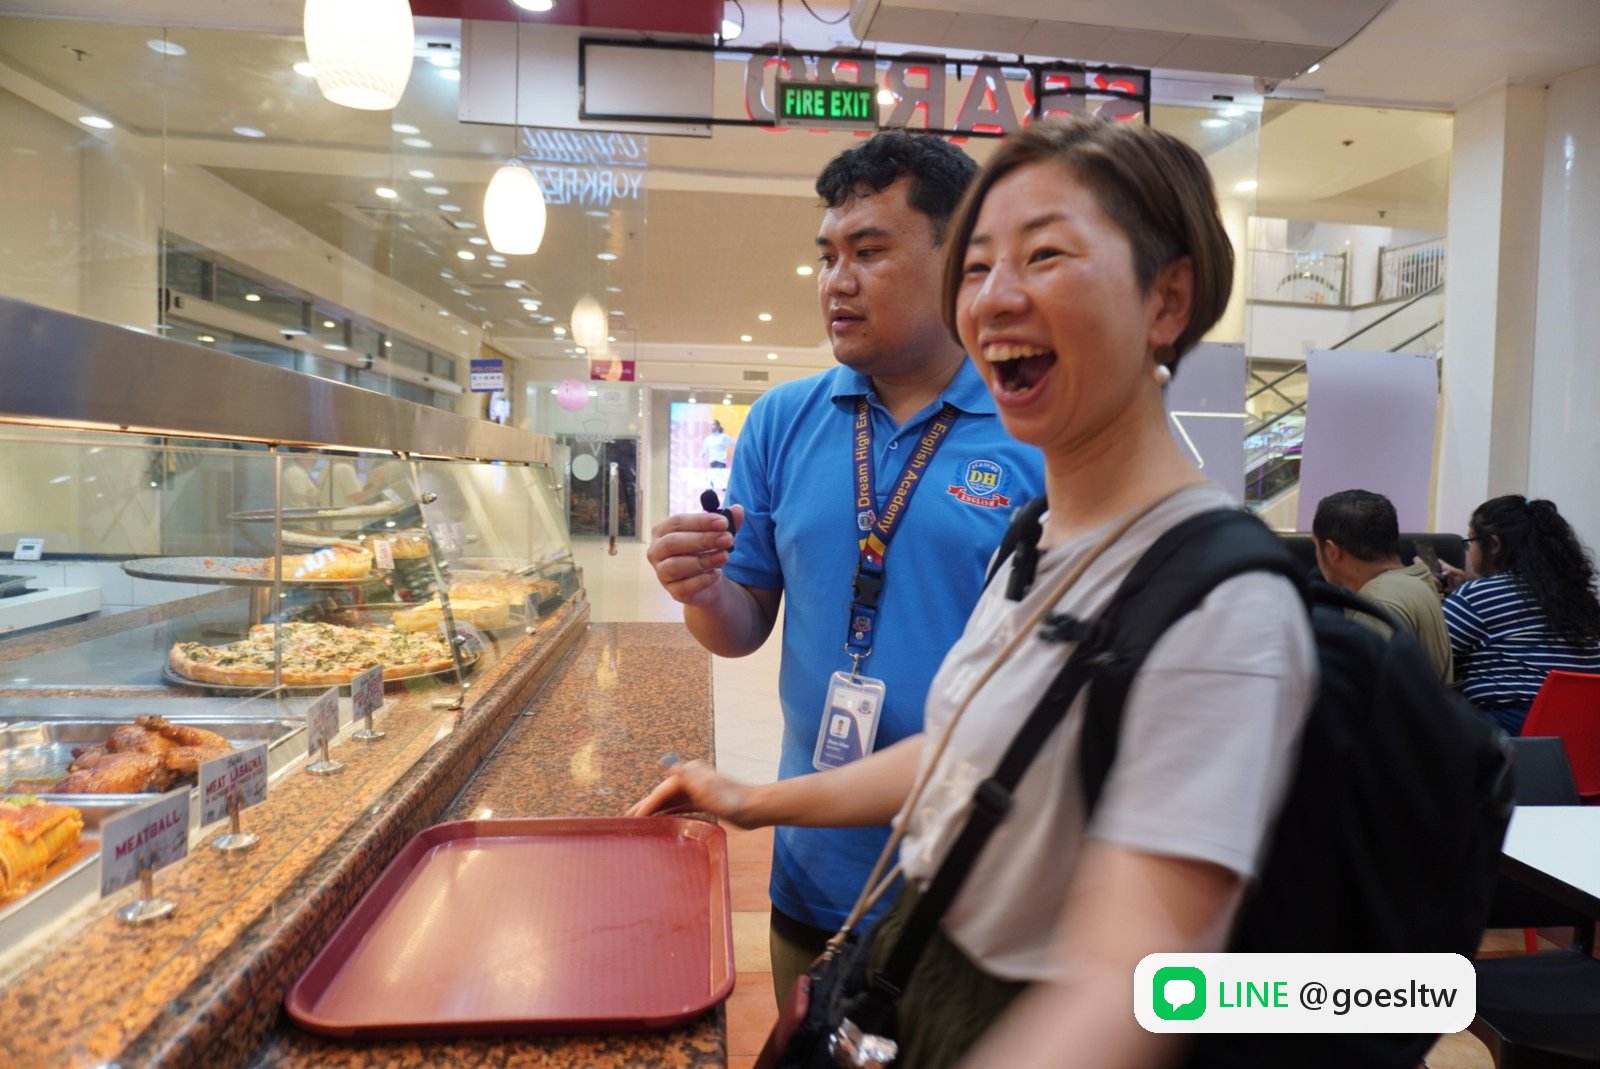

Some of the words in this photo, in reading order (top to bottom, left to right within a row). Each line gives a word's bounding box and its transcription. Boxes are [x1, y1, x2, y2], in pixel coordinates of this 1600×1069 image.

[785, 88, 825, 117] FIRE
[830, 90, 870, 118] EXIT
[855, 431, 870, 461] High
[911, 423, 948, 469] English
[857, 463, 870, 508] Dream
[969, 469, 998, 487] DH
[877, 469, 919, 534] Academy
[960, 494, 995, 507] ENGLISH
[205, 774, 226, 796] MEAT
[114, 809, 181, 861] MEATBALL
